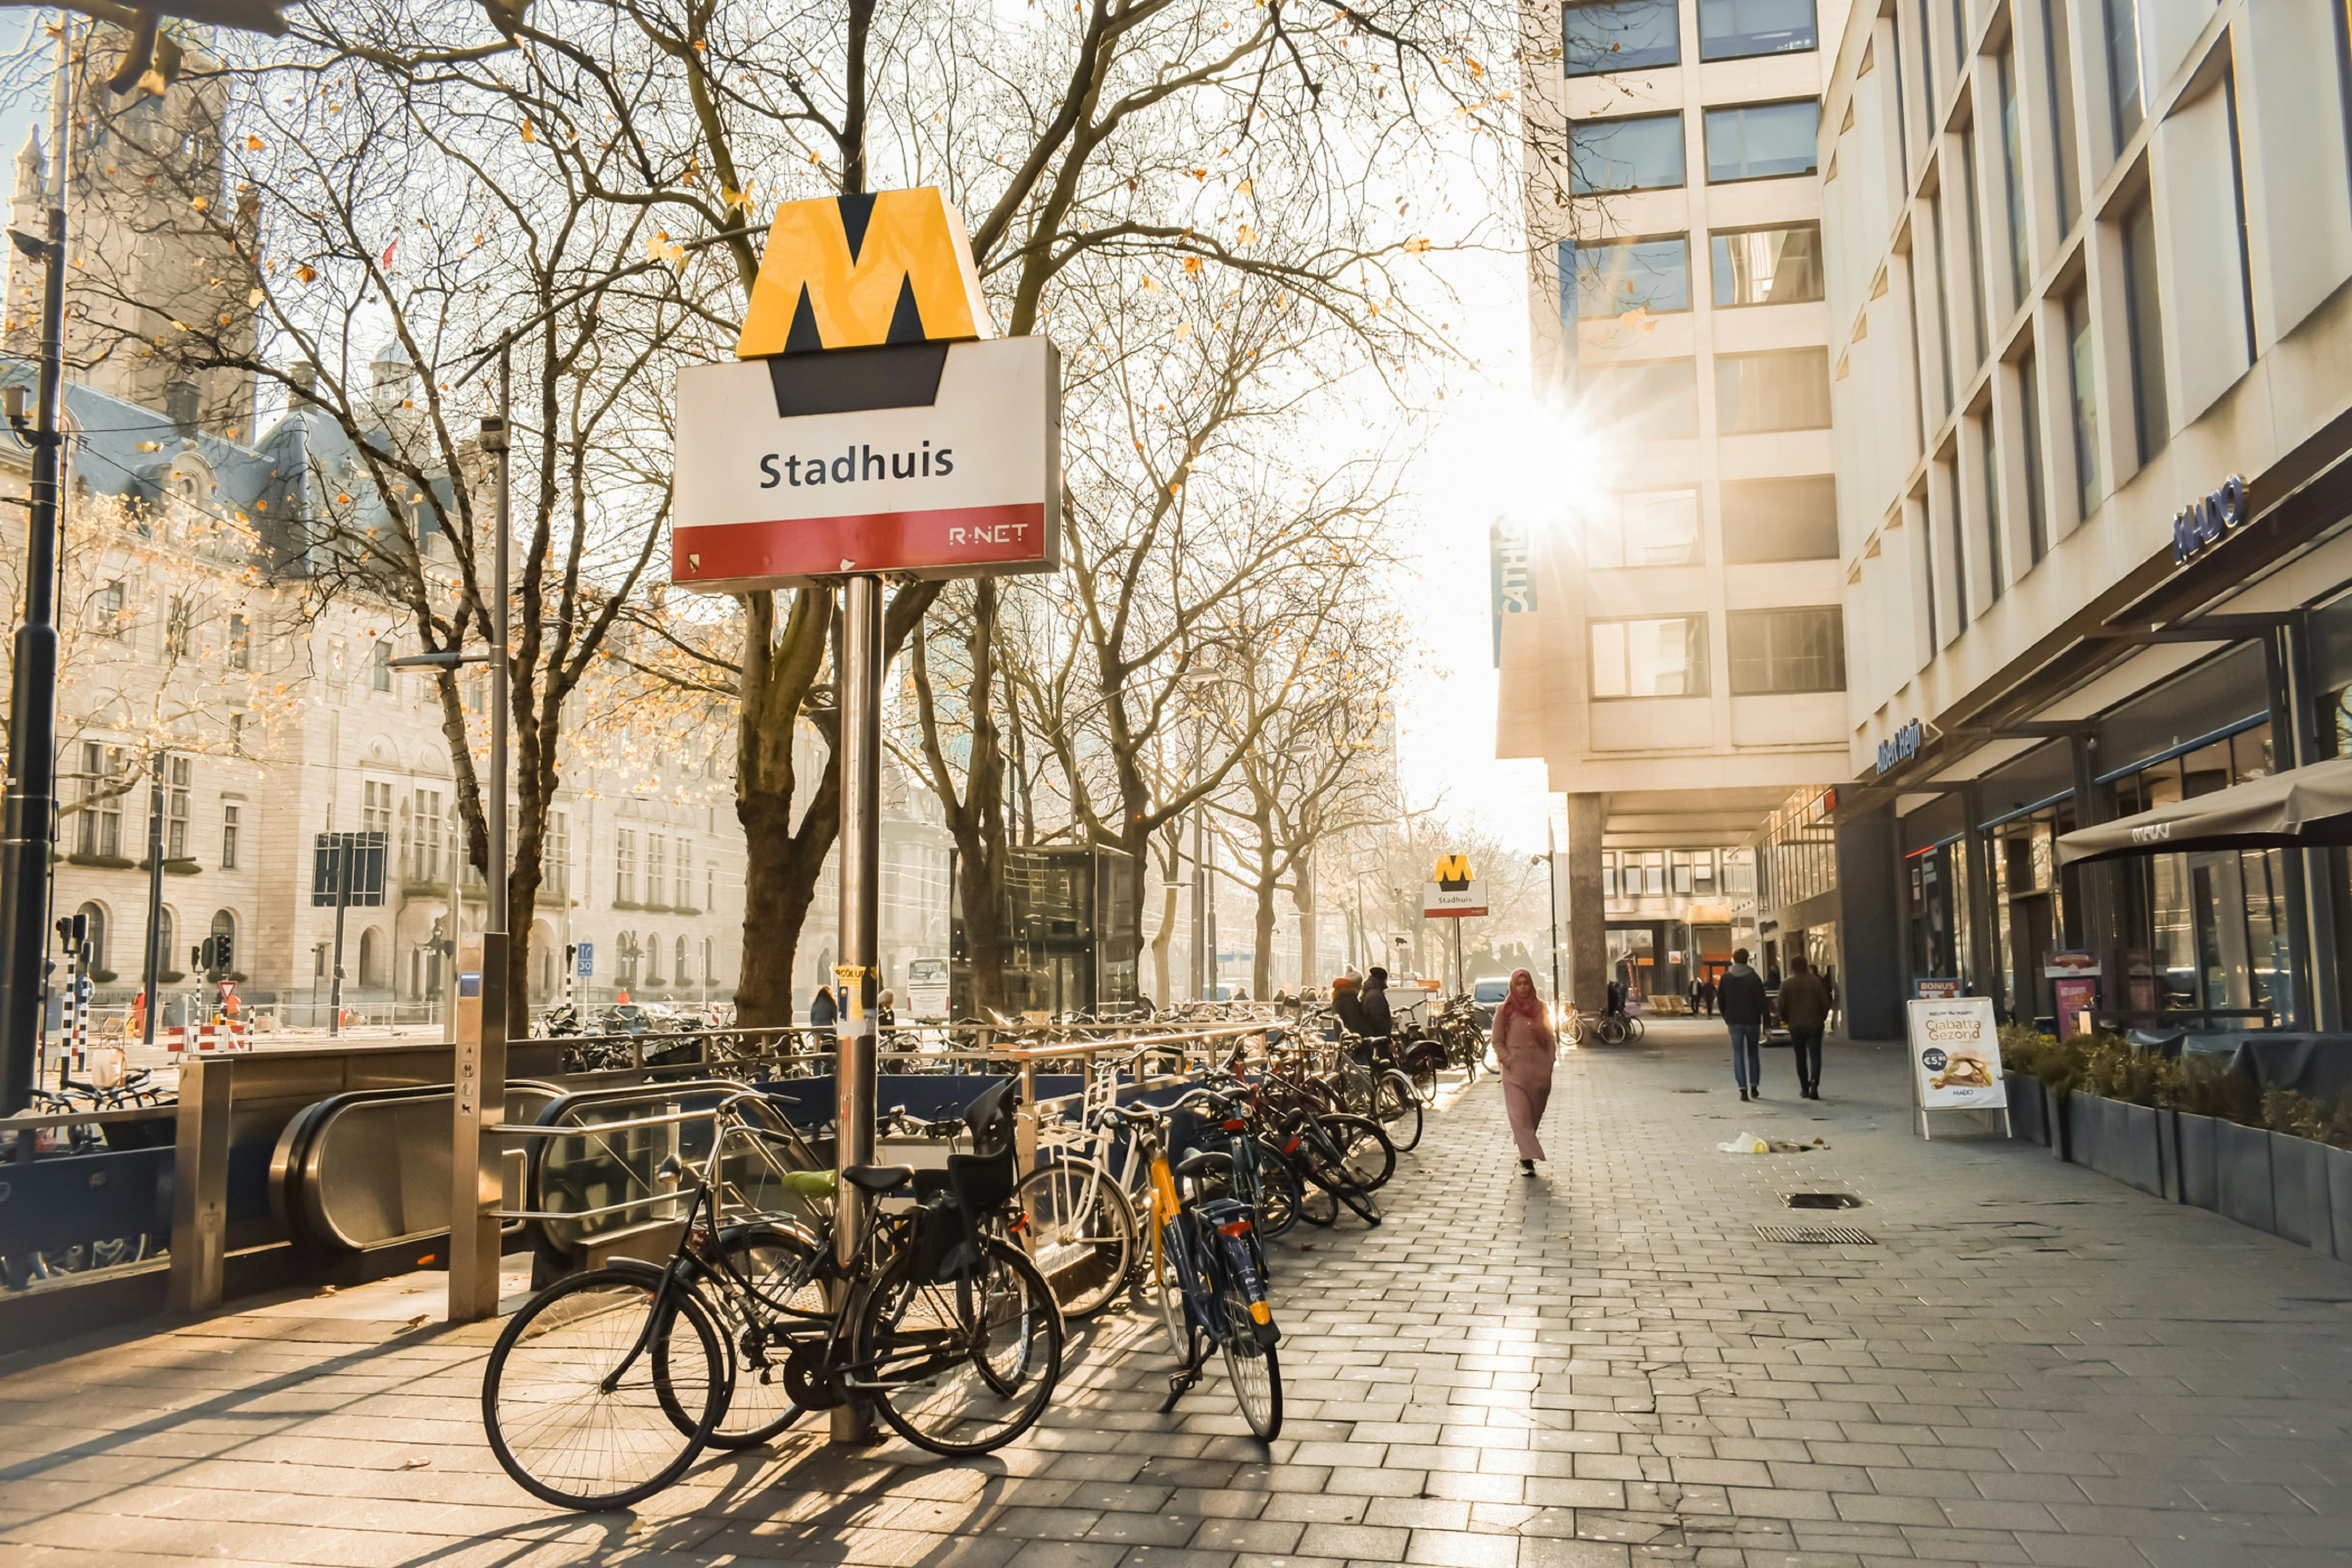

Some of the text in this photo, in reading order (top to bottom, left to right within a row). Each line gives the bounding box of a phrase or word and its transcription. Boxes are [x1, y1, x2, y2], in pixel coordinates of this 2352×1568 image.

[759, 441, 954, 489] Stadhuis
[1876, 719, 1921, 775] Albert Heijn
[1438, 895, 1472, 904] Stadhuis
[579, 962, 591, 971] 30
[1920, 982, 1955, 990] BONUS
[1926, 1020, 1981, 1030] Ciabatta
[1929, 1028, 1980, 1040] Gezond
